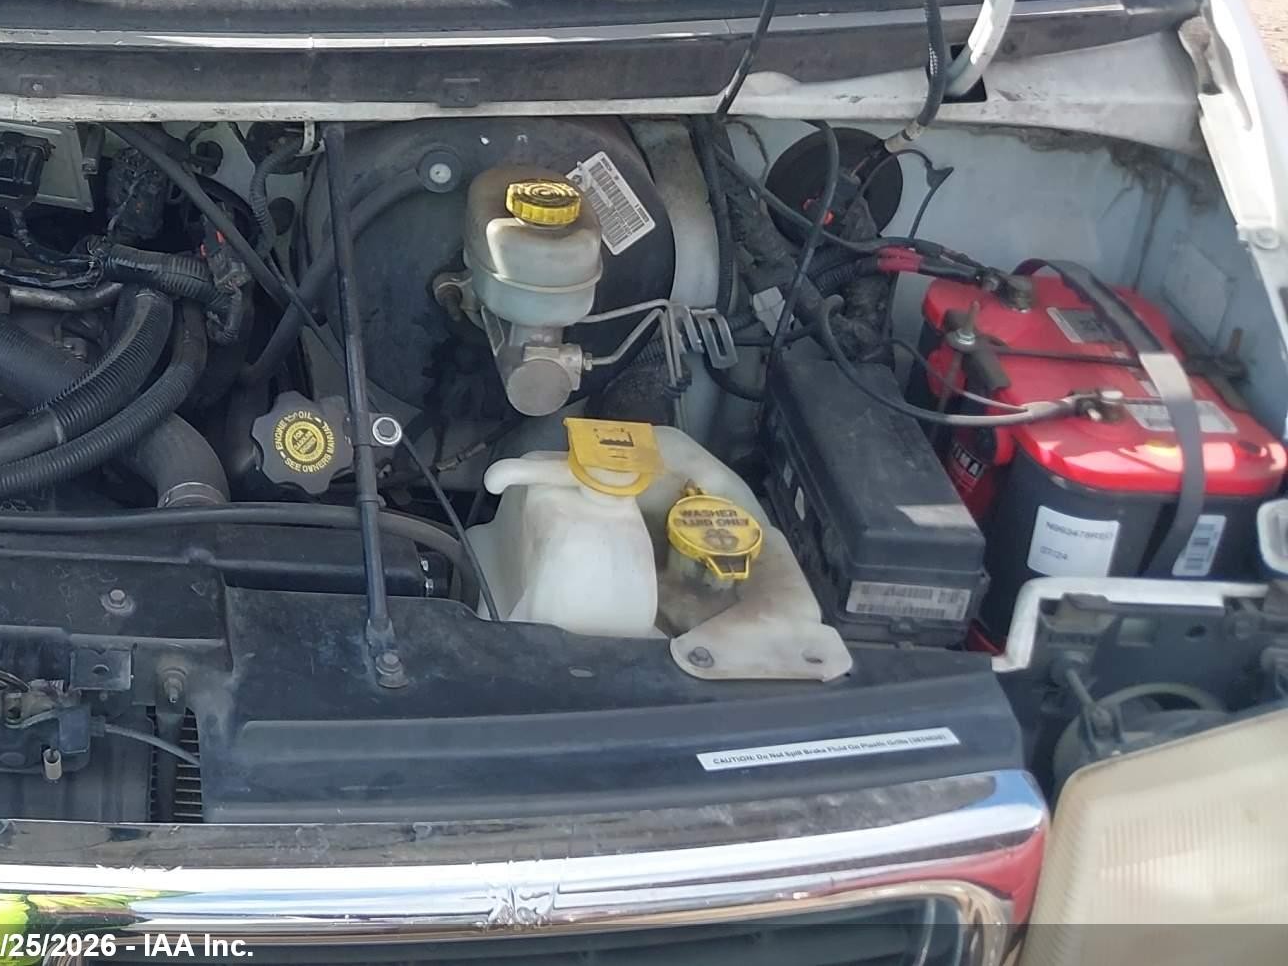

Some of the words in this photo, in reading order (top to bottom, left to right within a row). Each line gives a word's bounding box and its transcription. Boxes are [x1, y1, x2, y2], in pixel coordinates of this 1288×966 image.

[275, 420, 288, 451] ENGINE
[298, 410, 313, 420] OIL
[285, 457, 302, 472] SEE
[302, 453, 332, 472] OWNERS
[322, 421, 334, 454] MANUAL
[680, 510, 737, 518] WASHER
[715, 518, 748, 526] ONLY
[713, 755, 757, 764] CAUTION:
[785, 750, 802, 758] Spill
[803, 748, 827, 756] Brake
